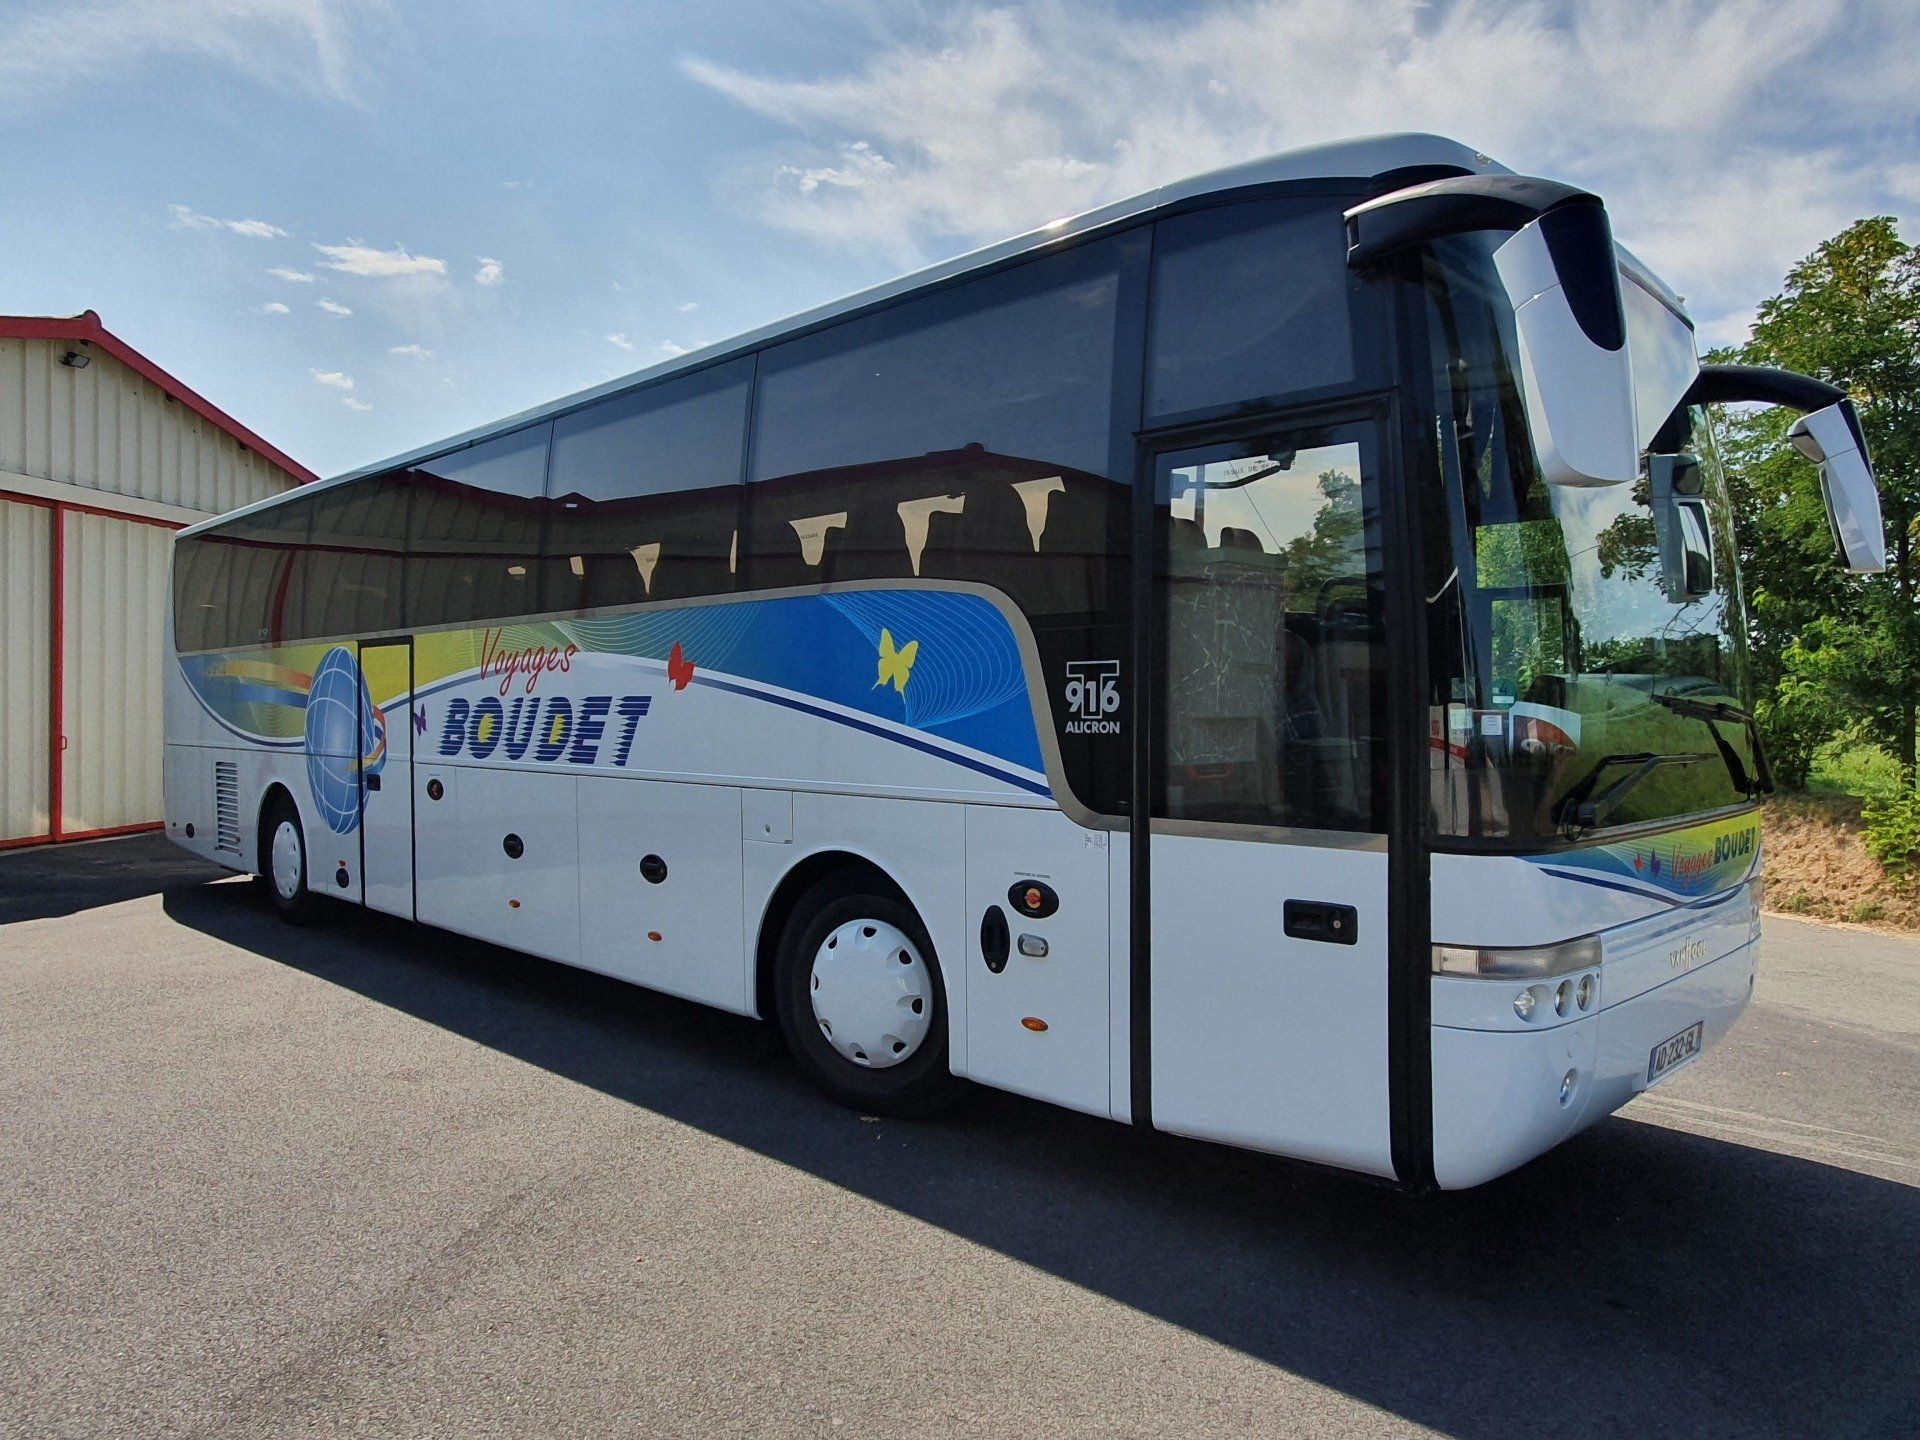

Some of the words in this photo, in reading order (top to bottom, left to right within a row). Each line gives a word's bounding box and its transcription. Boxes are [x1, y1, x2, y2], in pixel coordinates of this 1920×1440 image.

[480, 628, 580, 696] Voyages
[438, 695, 652, 767] BOUDET
[1065, 720, 1120, 734] ALICRON
[1713, 826, 1756, 865] BOUDET
